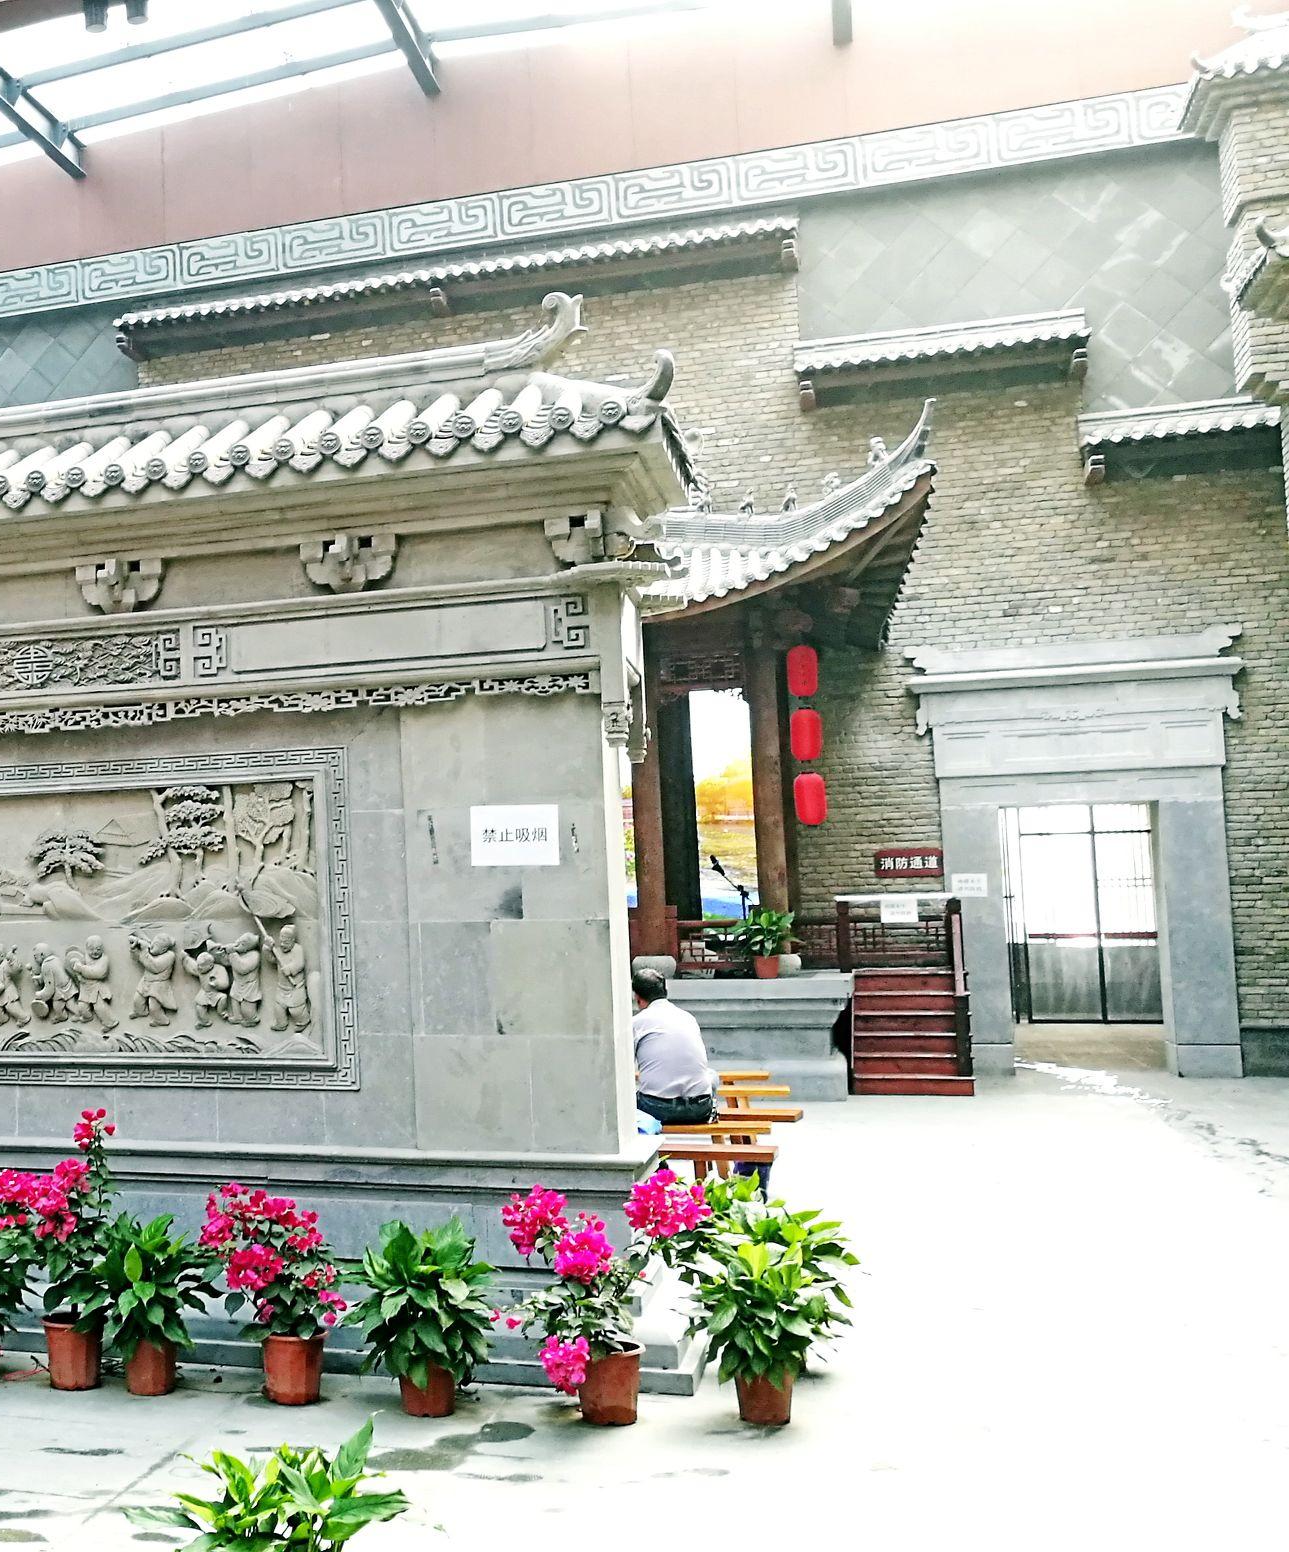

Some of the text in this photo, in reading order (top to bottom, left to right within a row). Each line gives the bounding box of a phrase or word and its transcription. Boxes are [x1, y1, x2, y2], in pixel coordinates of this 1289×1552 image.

[482, 827, 548, 843] 禁止吸烟
[880, 855, 939, 870] 消防通道
